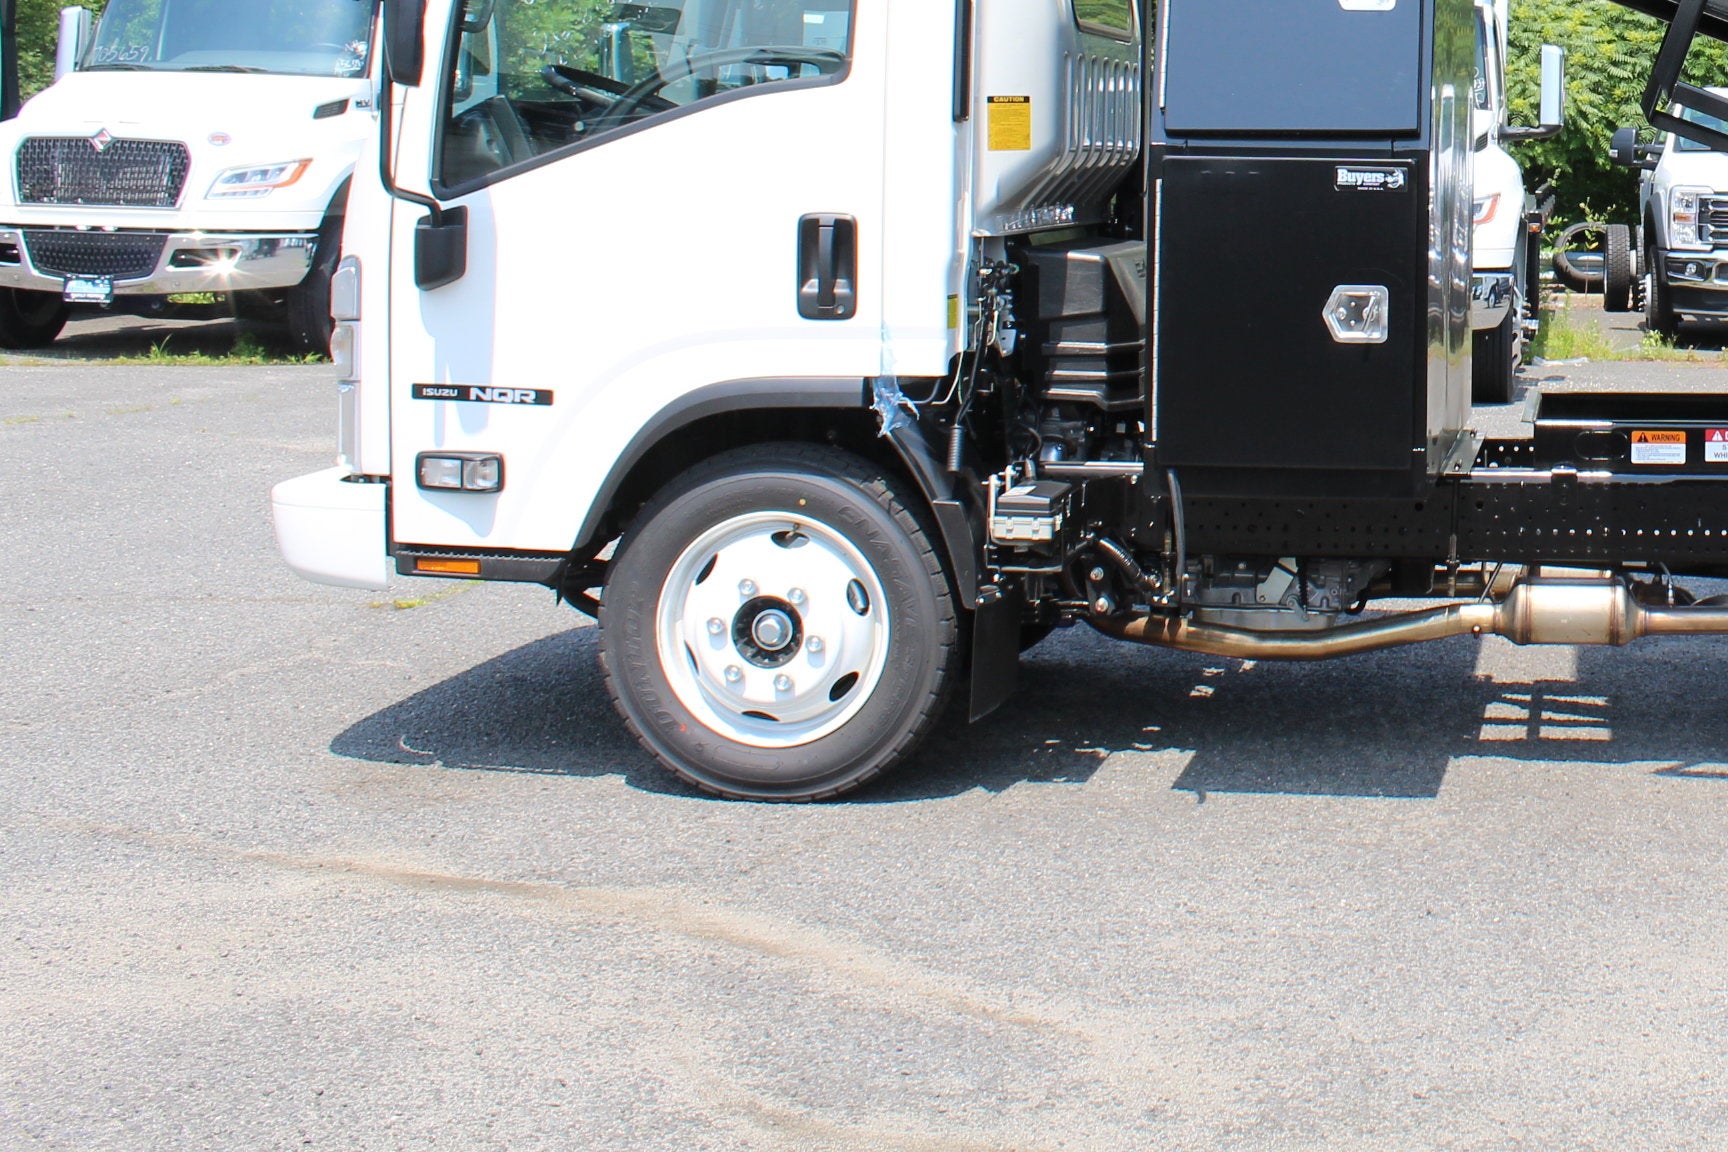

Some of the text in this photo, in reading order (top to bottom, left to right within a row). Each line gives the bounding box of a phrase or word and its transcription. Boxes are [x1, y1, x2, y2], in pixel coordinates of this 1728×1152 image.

[1337, 168, 1385, 186] Buyers
[422, 387, 536, 404] ISUZU NQR
[1651, 432, 1681, 442] WARNING
